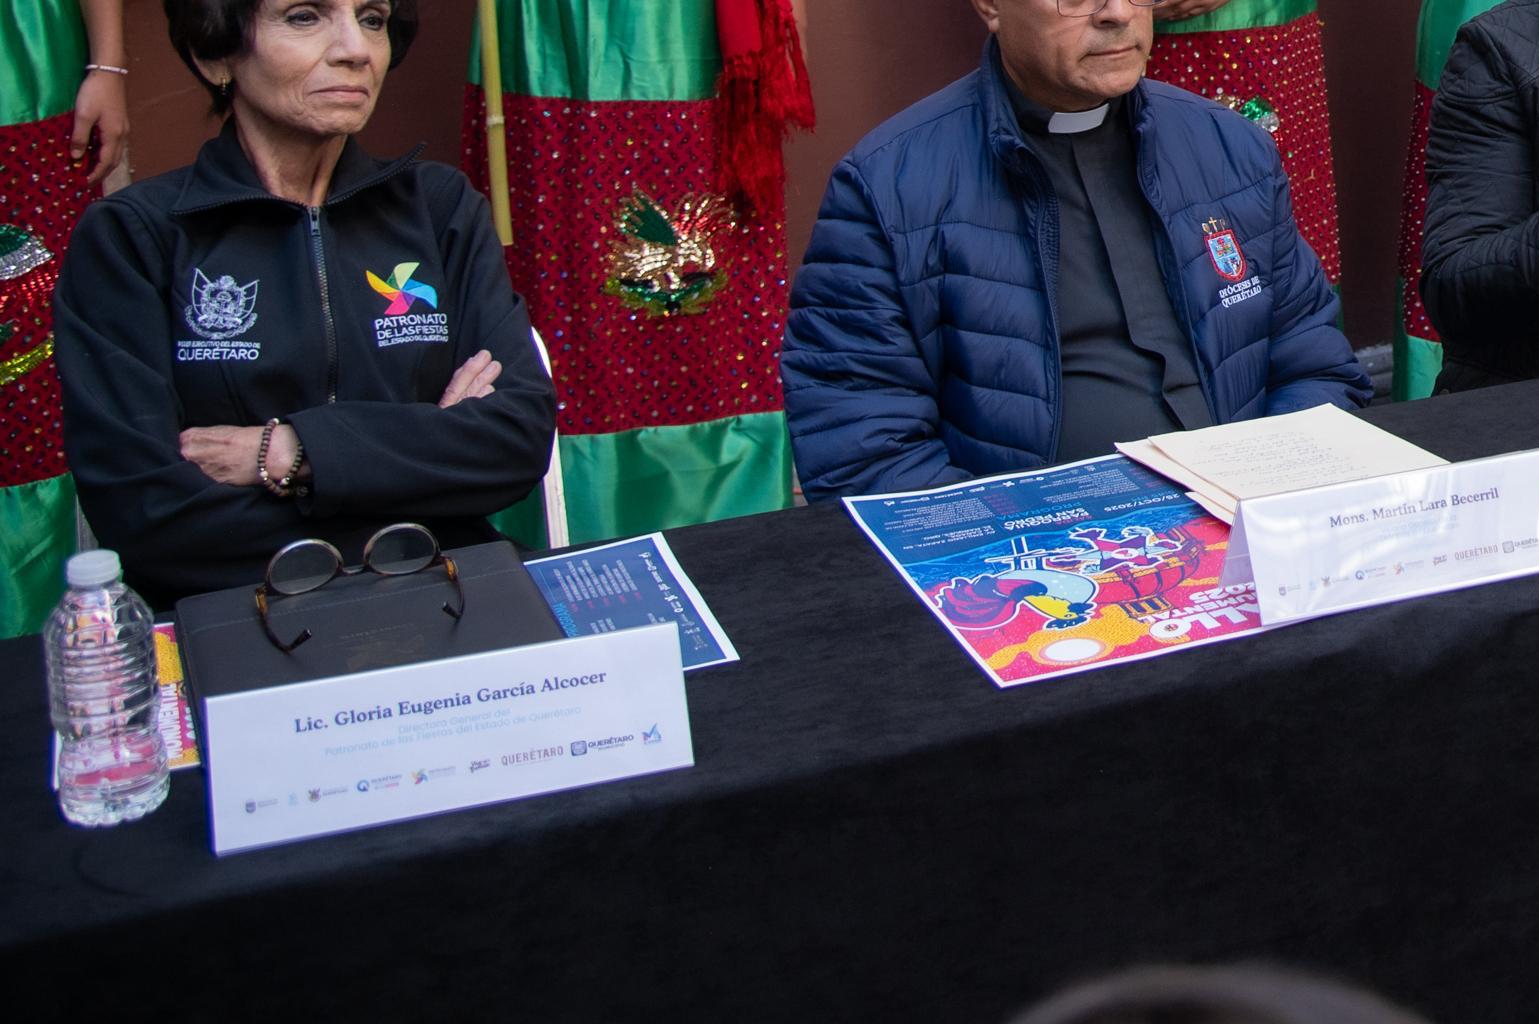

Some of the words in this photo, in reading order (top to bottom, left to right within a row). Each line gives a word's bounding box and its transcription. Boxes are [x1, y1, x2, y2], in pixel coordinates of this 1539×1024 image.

[1218, 278, 1252, 299] DIÓCESIS
[1251, 275, 1261, 285] DE
[1221, 285, 1262, 308] QUERÉTARO
[375, 313, 448, 330] PATRONATO
[377, 329, 393, 339] DE
[394, 326, 416, 337] LAS
[415, 325, 449, 335] FIESTAS
[177, 347, 259, 361] QUERÉTARO
[1329, 511, 1369, 528] Mons.
[1372, 502, 1417, 521] Martín
[1419, 496, 1448, 512] Lara
[1450, 487, 1500, 507] Becerril
[294, 716, 330, 735] Lic.
[334, 704, 393, 729] Gloria
[397, 691, 472, 721] Eugenia
[476, 681, 536, 704] García
[540, 669, 608, 694] Alcocer
[448, 712, 492, 728] General
[587, 734, 635, 751] QUERÉTARO
[500, 745, 564, 767] QUERÉTARO
